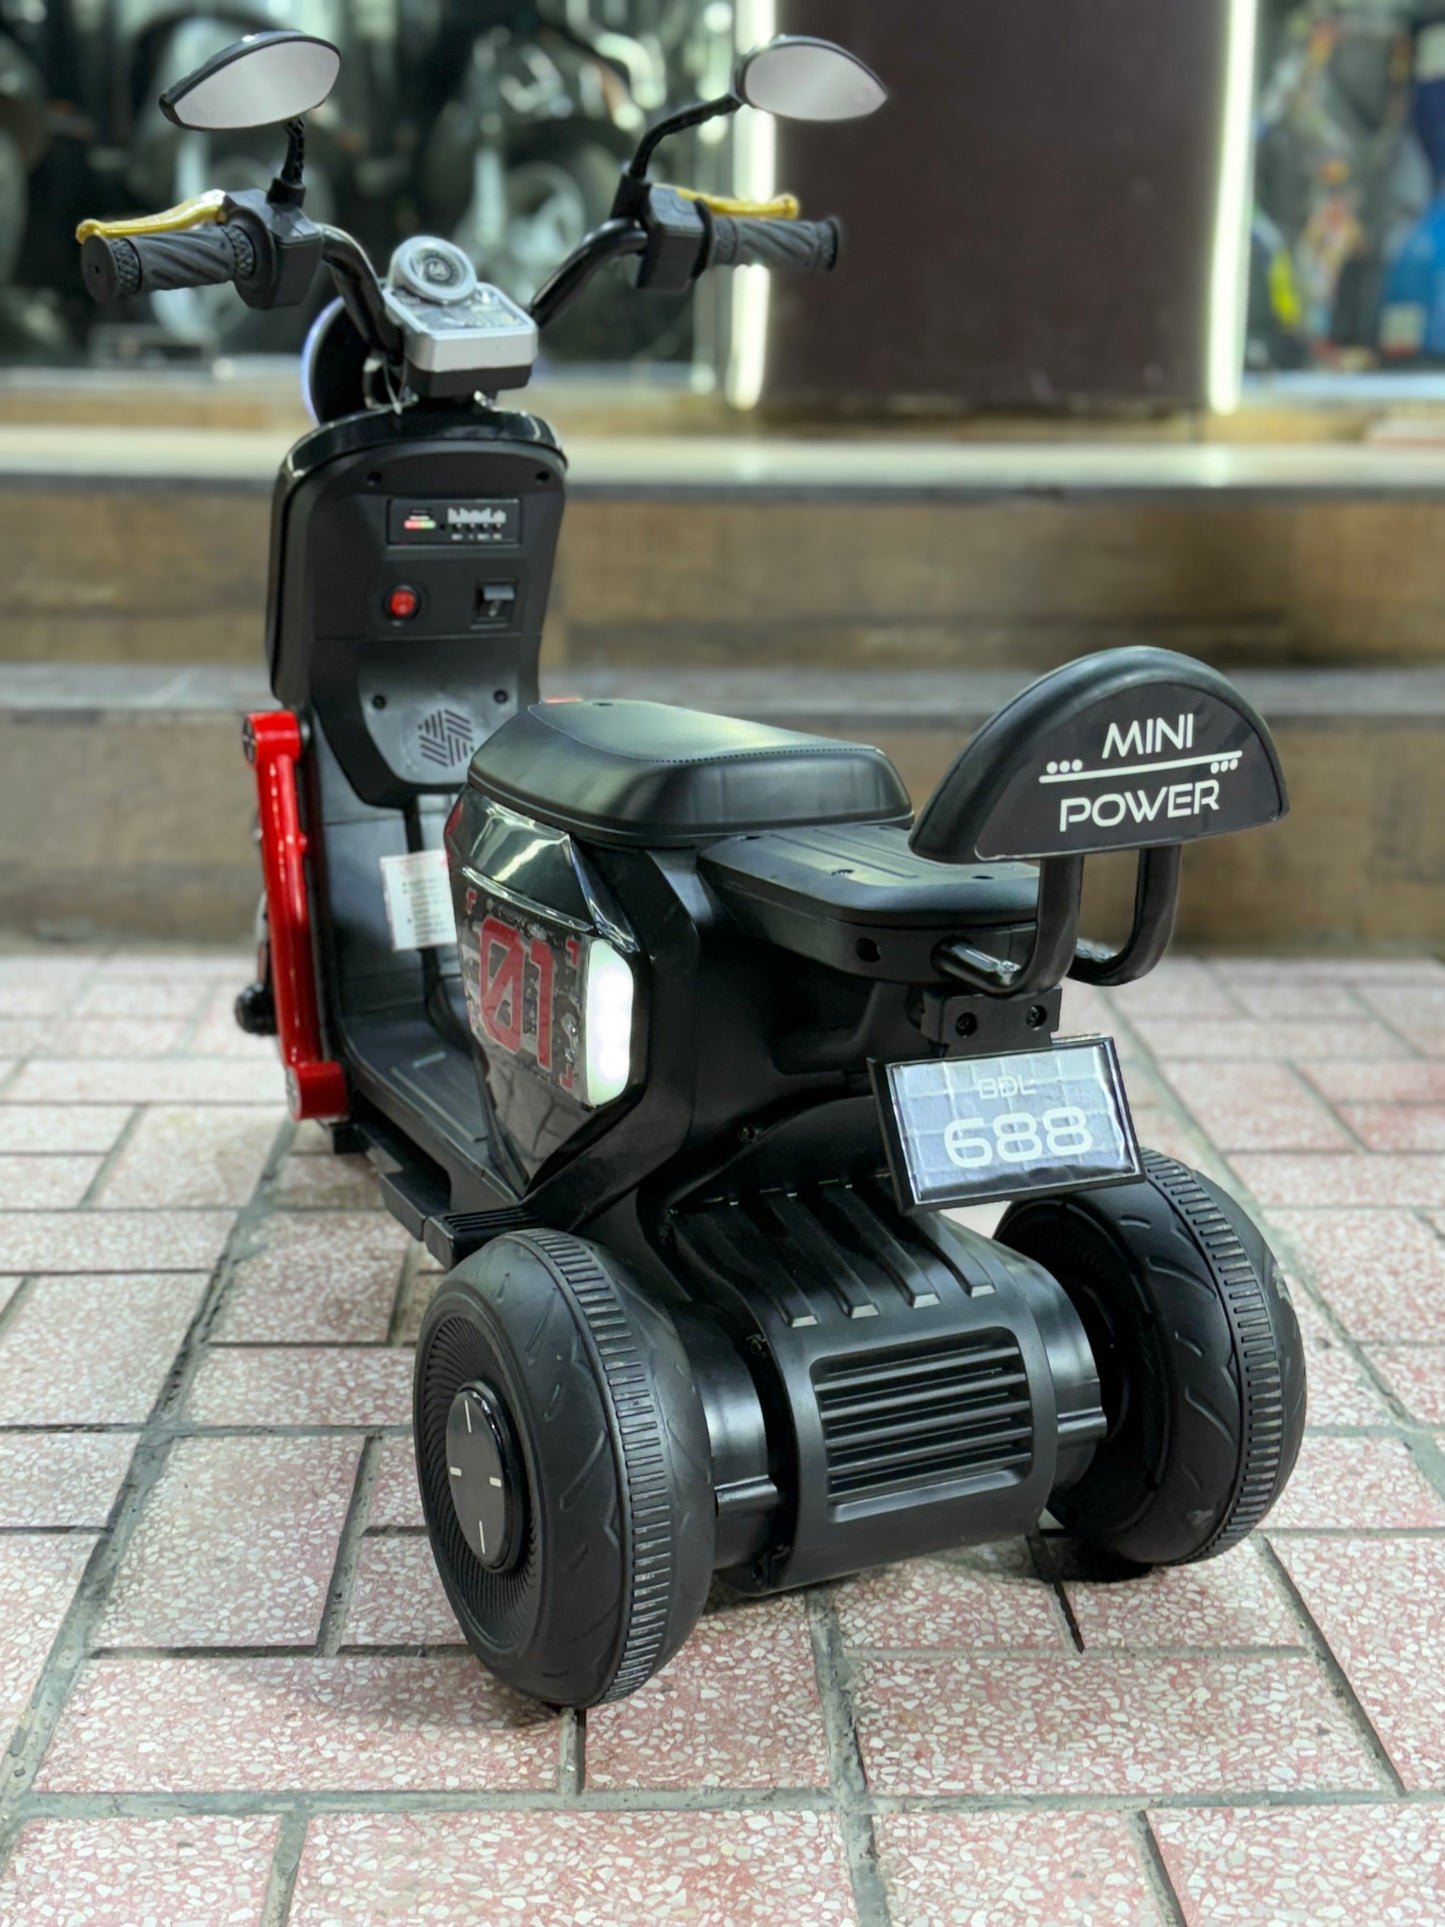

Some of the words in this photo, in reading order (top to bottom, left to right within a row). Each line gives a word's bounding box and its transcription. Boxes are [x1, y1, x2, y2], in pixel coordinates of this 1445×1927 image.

[1101, 712, 1194, 760] MINI
[1059, 779, 1220, 832] POWER
[977, 1075, 1036, 1100] BDL
[944, 1106, 1093, 1168] 688
